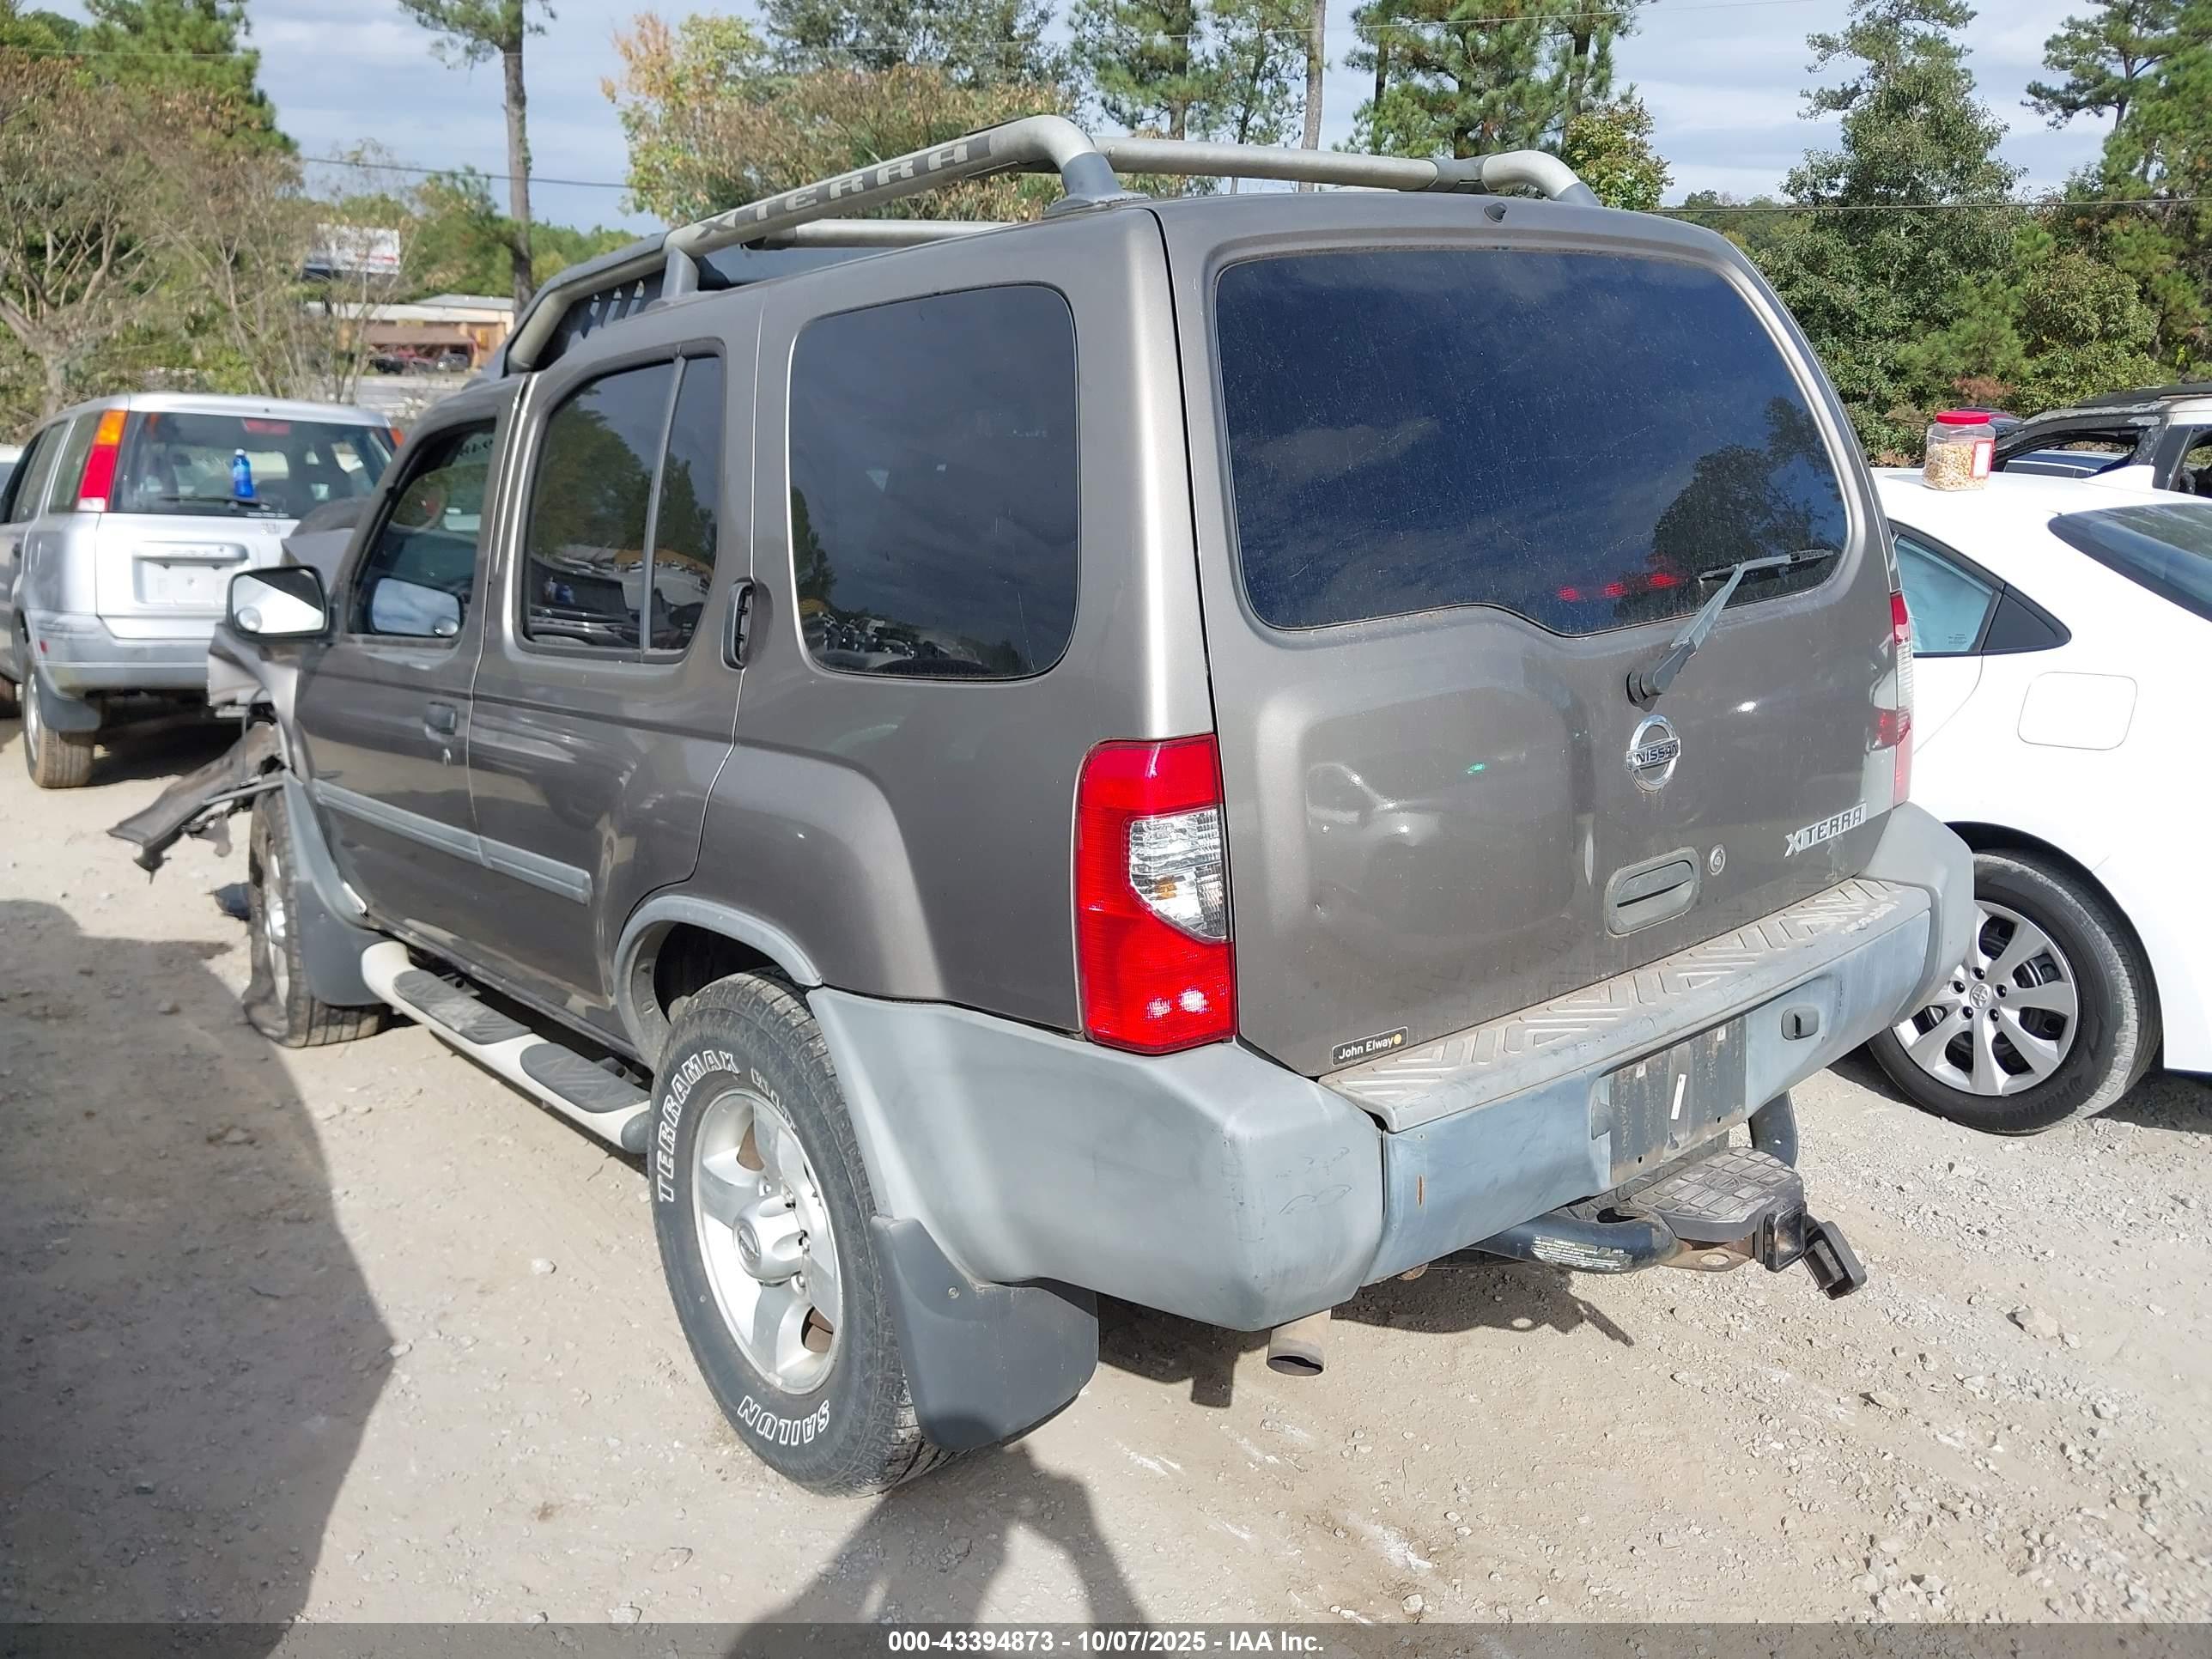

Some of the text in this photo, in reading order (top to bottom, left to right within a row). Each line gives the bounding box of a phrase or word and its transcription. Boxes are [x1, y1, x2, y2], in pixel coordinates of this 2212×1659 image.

[696, 143, 969, 240] XTERRA
[1635, 743, 1679, 763] NISSAN
[1784, 804, 1865, 858] XTERRA
[1338, 1036, 1395, 1060] John Elway
[657, 1049, 740, 1203] TERRAMAX
[737, 1395, 830, 1446] SAILUN
